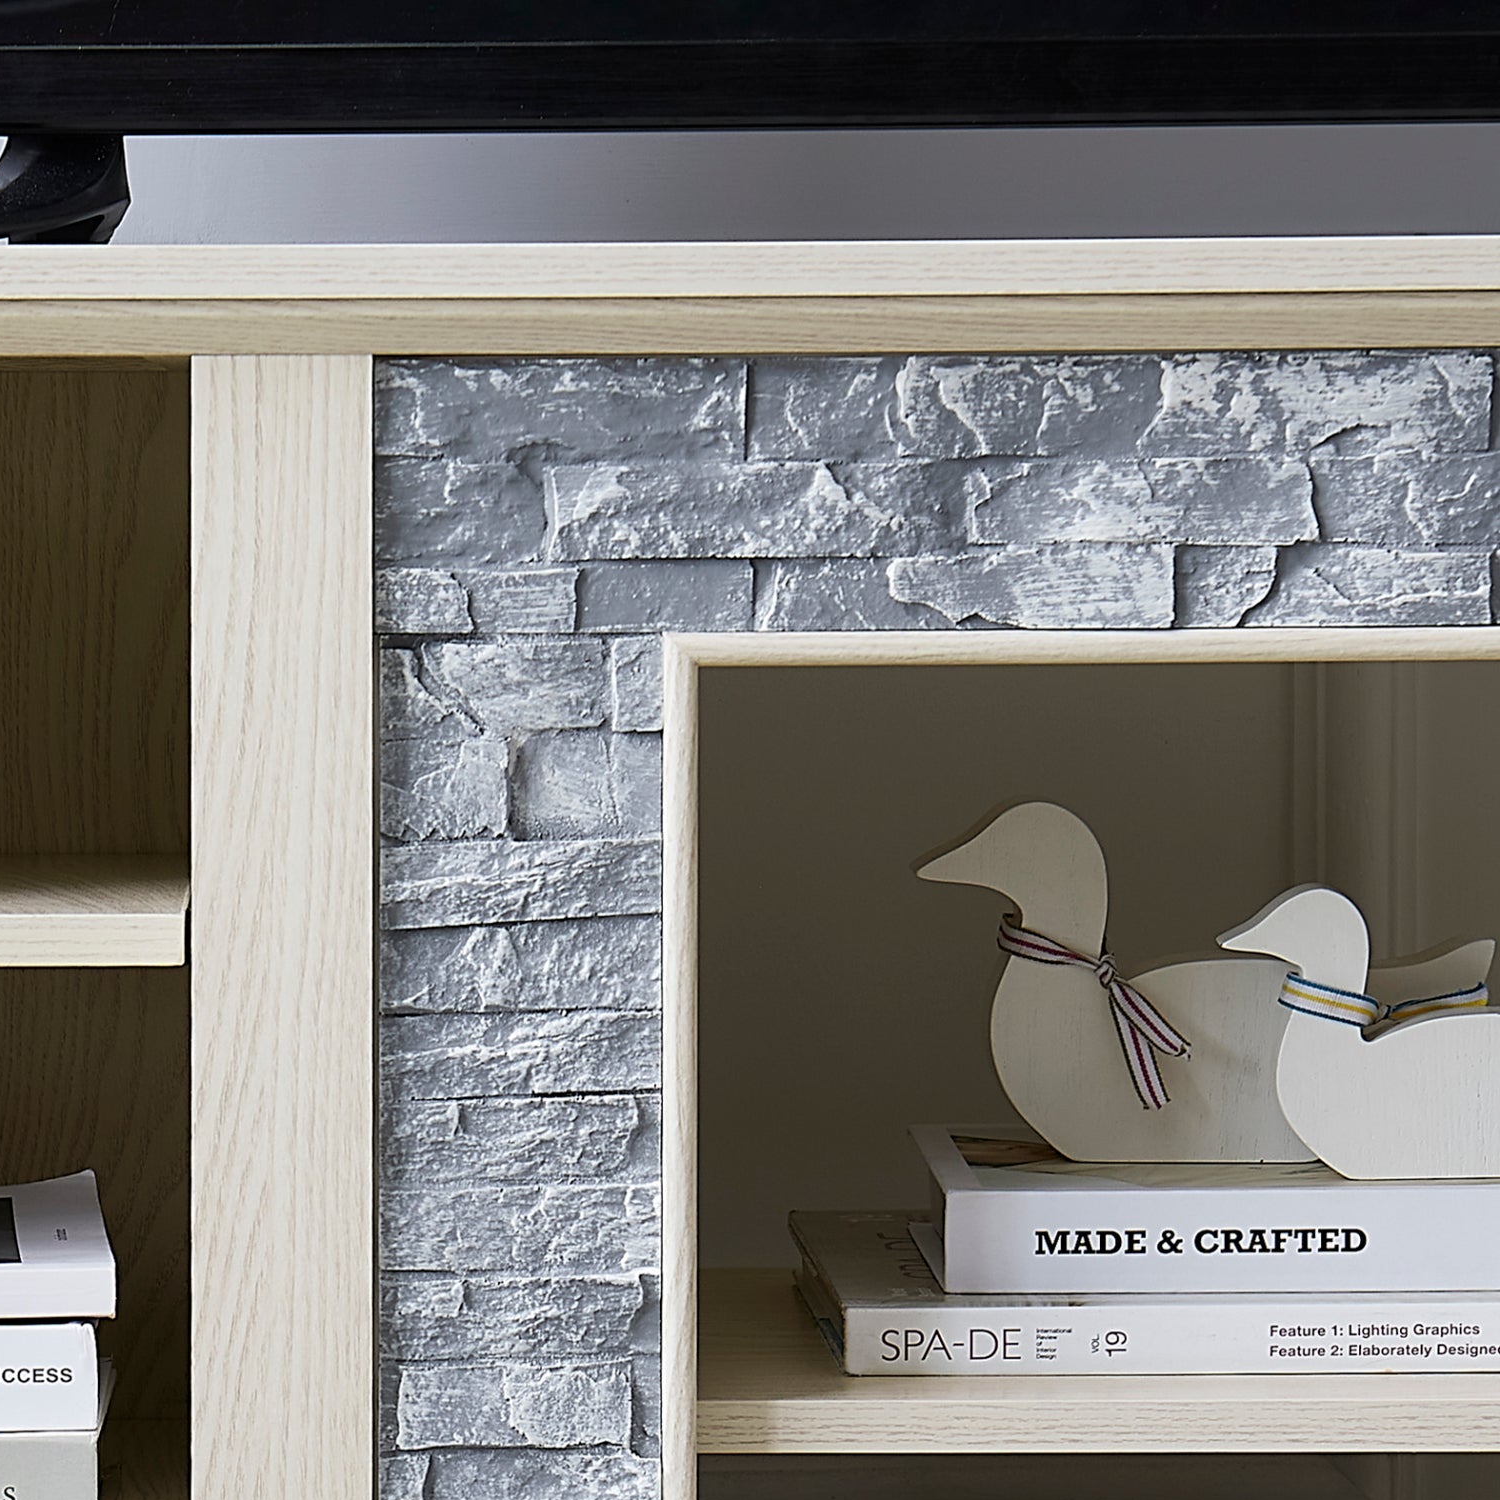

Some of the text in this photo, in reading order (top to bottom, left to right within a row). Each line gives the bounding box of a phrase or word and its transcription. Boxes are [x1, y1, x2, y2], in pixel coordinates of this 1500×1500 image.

[1034, 1228, 1368, 1256] MADE & CRAFTED
[1104, 1330, 1128, 1358] 19
[1269, 1322, 1481, 1339] Feature 1: Lighting Graphics
[881, 1328, 1022, 1362] SPA-DE
[1269, 1342, 1500, 1359] Feature 2: Elaborately Designe
